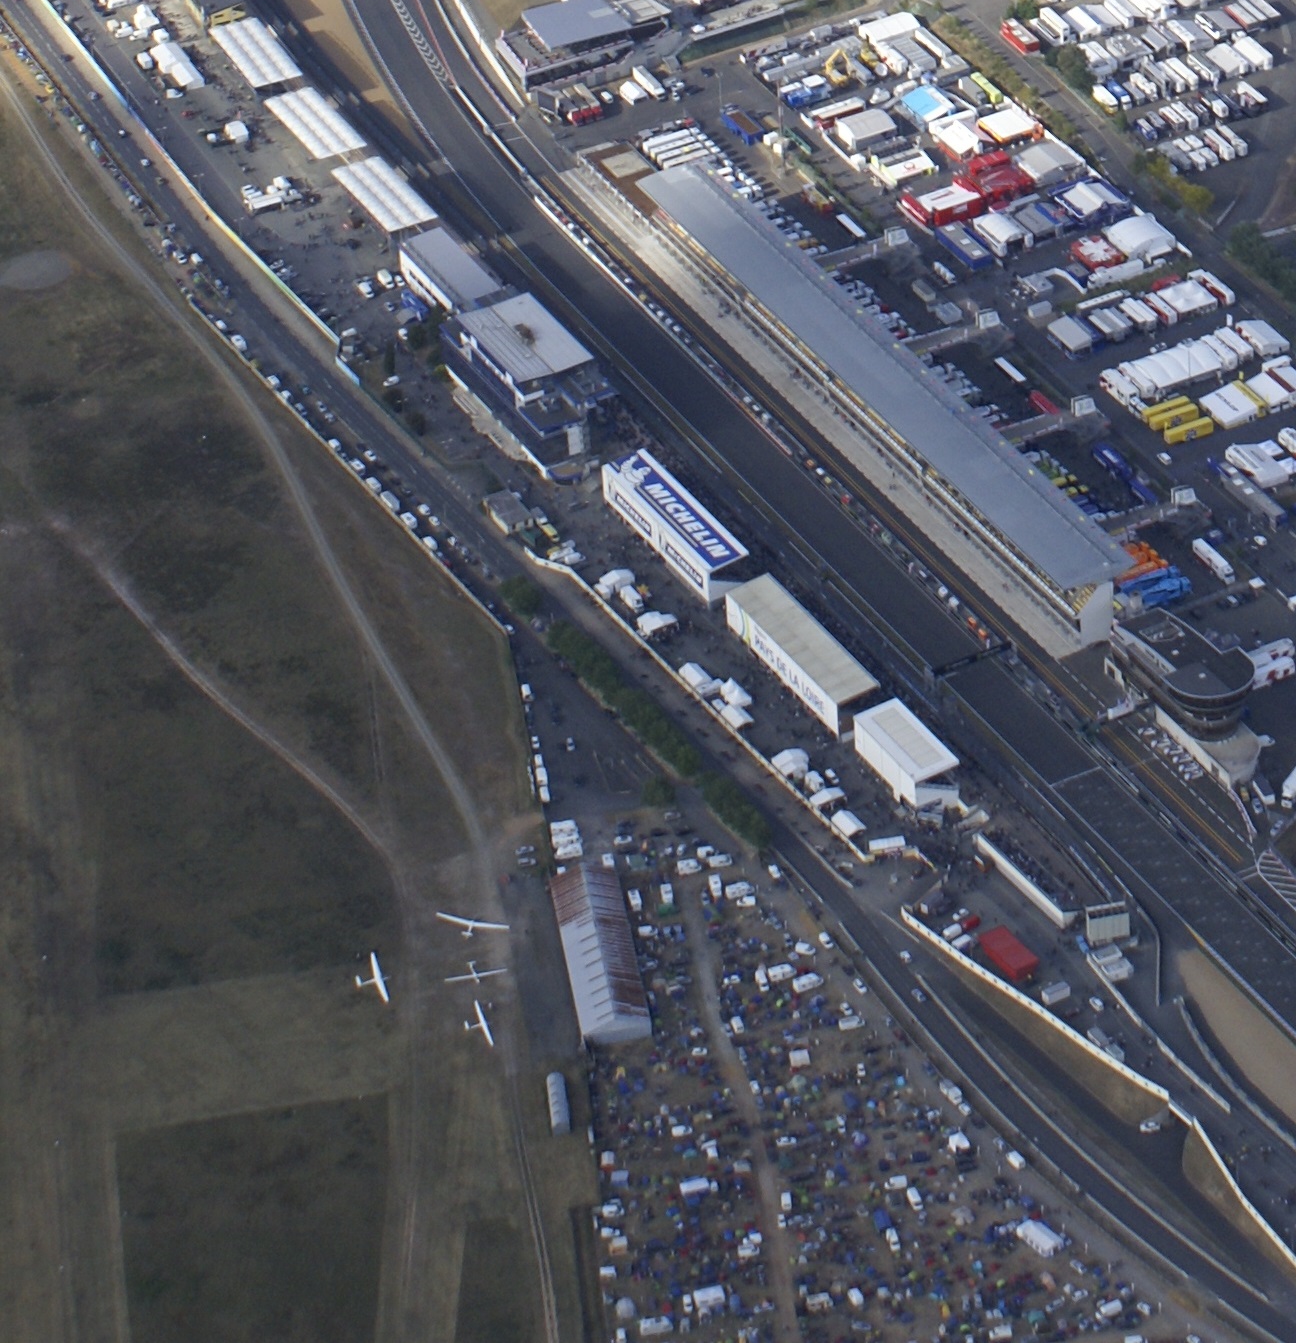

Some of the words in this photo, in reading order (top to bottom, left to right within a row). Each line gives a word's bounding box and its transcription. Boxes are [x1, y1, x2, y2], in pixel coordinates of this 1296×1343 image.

[616, 494, 652, 534] MICHELIN
[644, 482, 731, 560] MICHELIN
[666, 544, 703, 586] MICHELIN
[754, 634, 775, 664] PAYS
[776, 657, 787, 677] DE
[789, 668, 800, 689] LA
[801, 681, 824, 715] LOIRE
